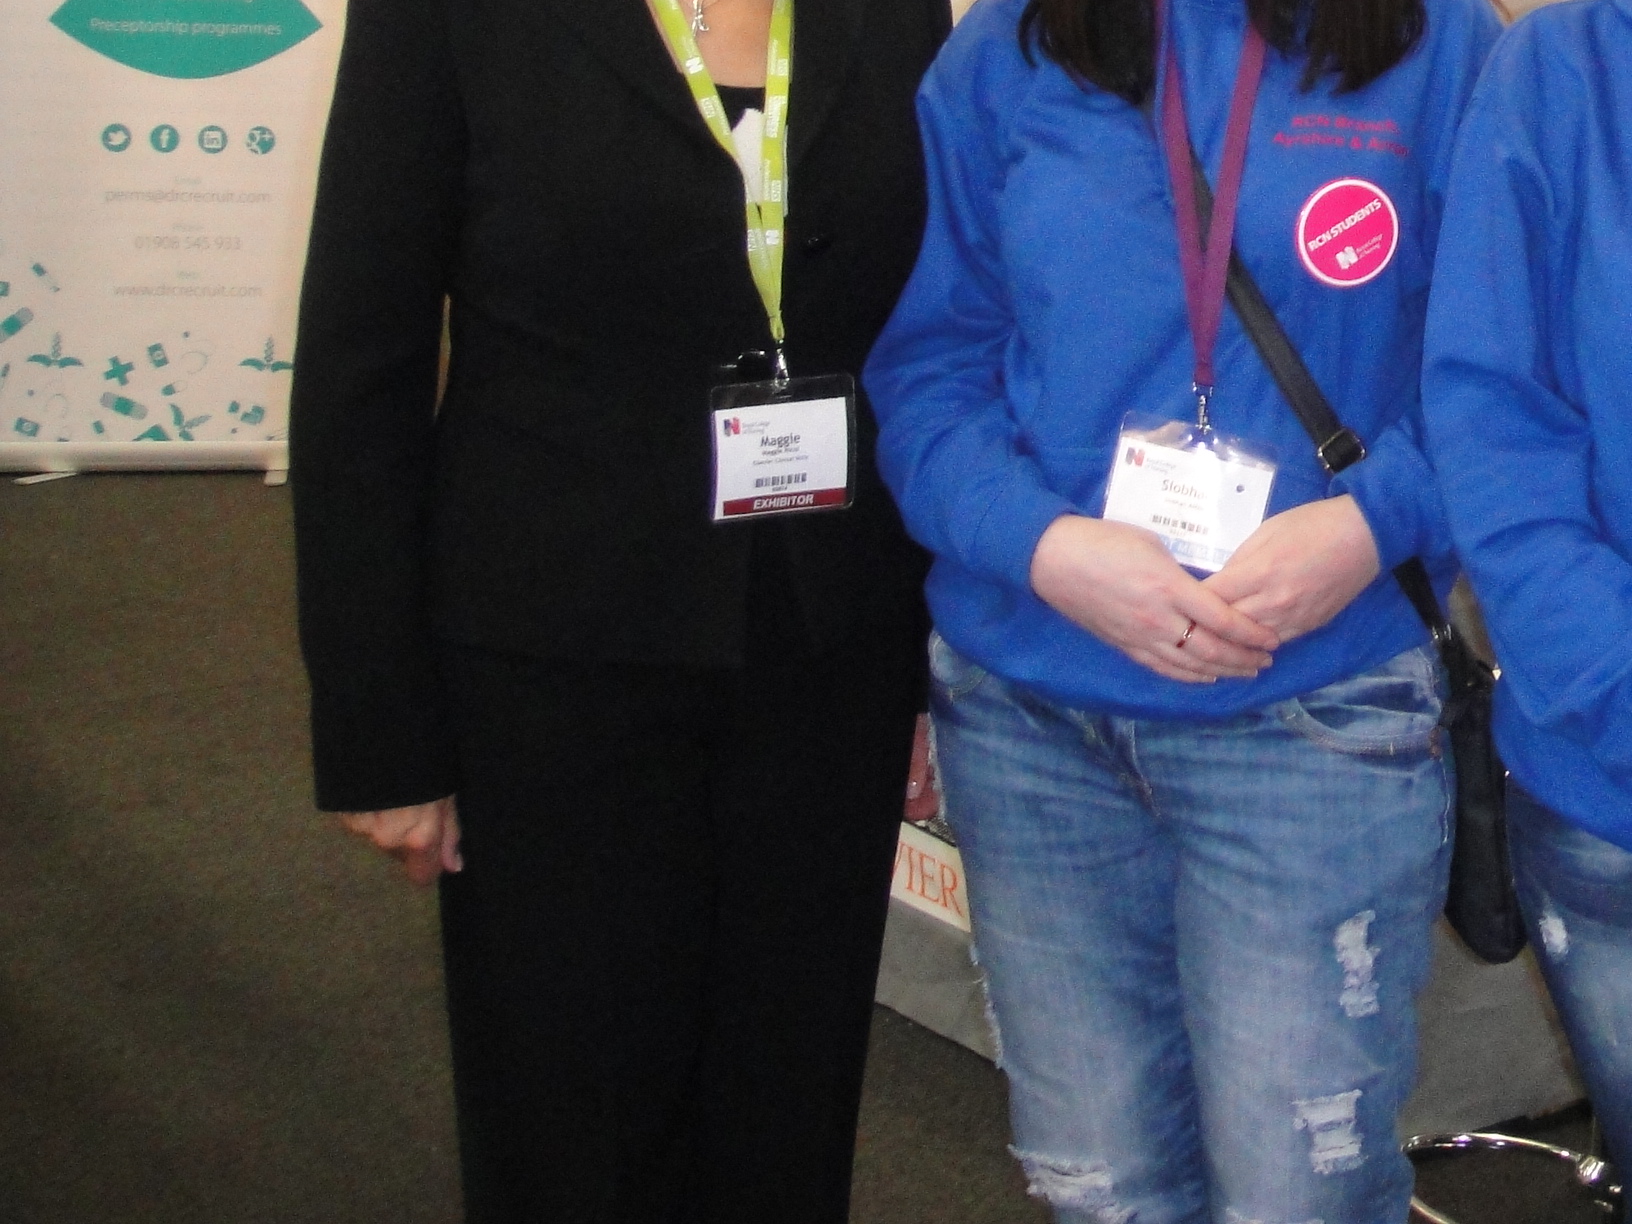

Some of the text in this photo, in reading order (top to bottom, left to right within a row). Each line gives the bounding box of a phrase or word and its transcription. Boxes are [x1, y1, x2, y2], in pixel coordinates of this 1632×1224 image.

[760, 432, 801, 448] Maggie
[1161, 478, 1205, 500] Siobha
[753, 494, 815, 511] EXHIBITOR
